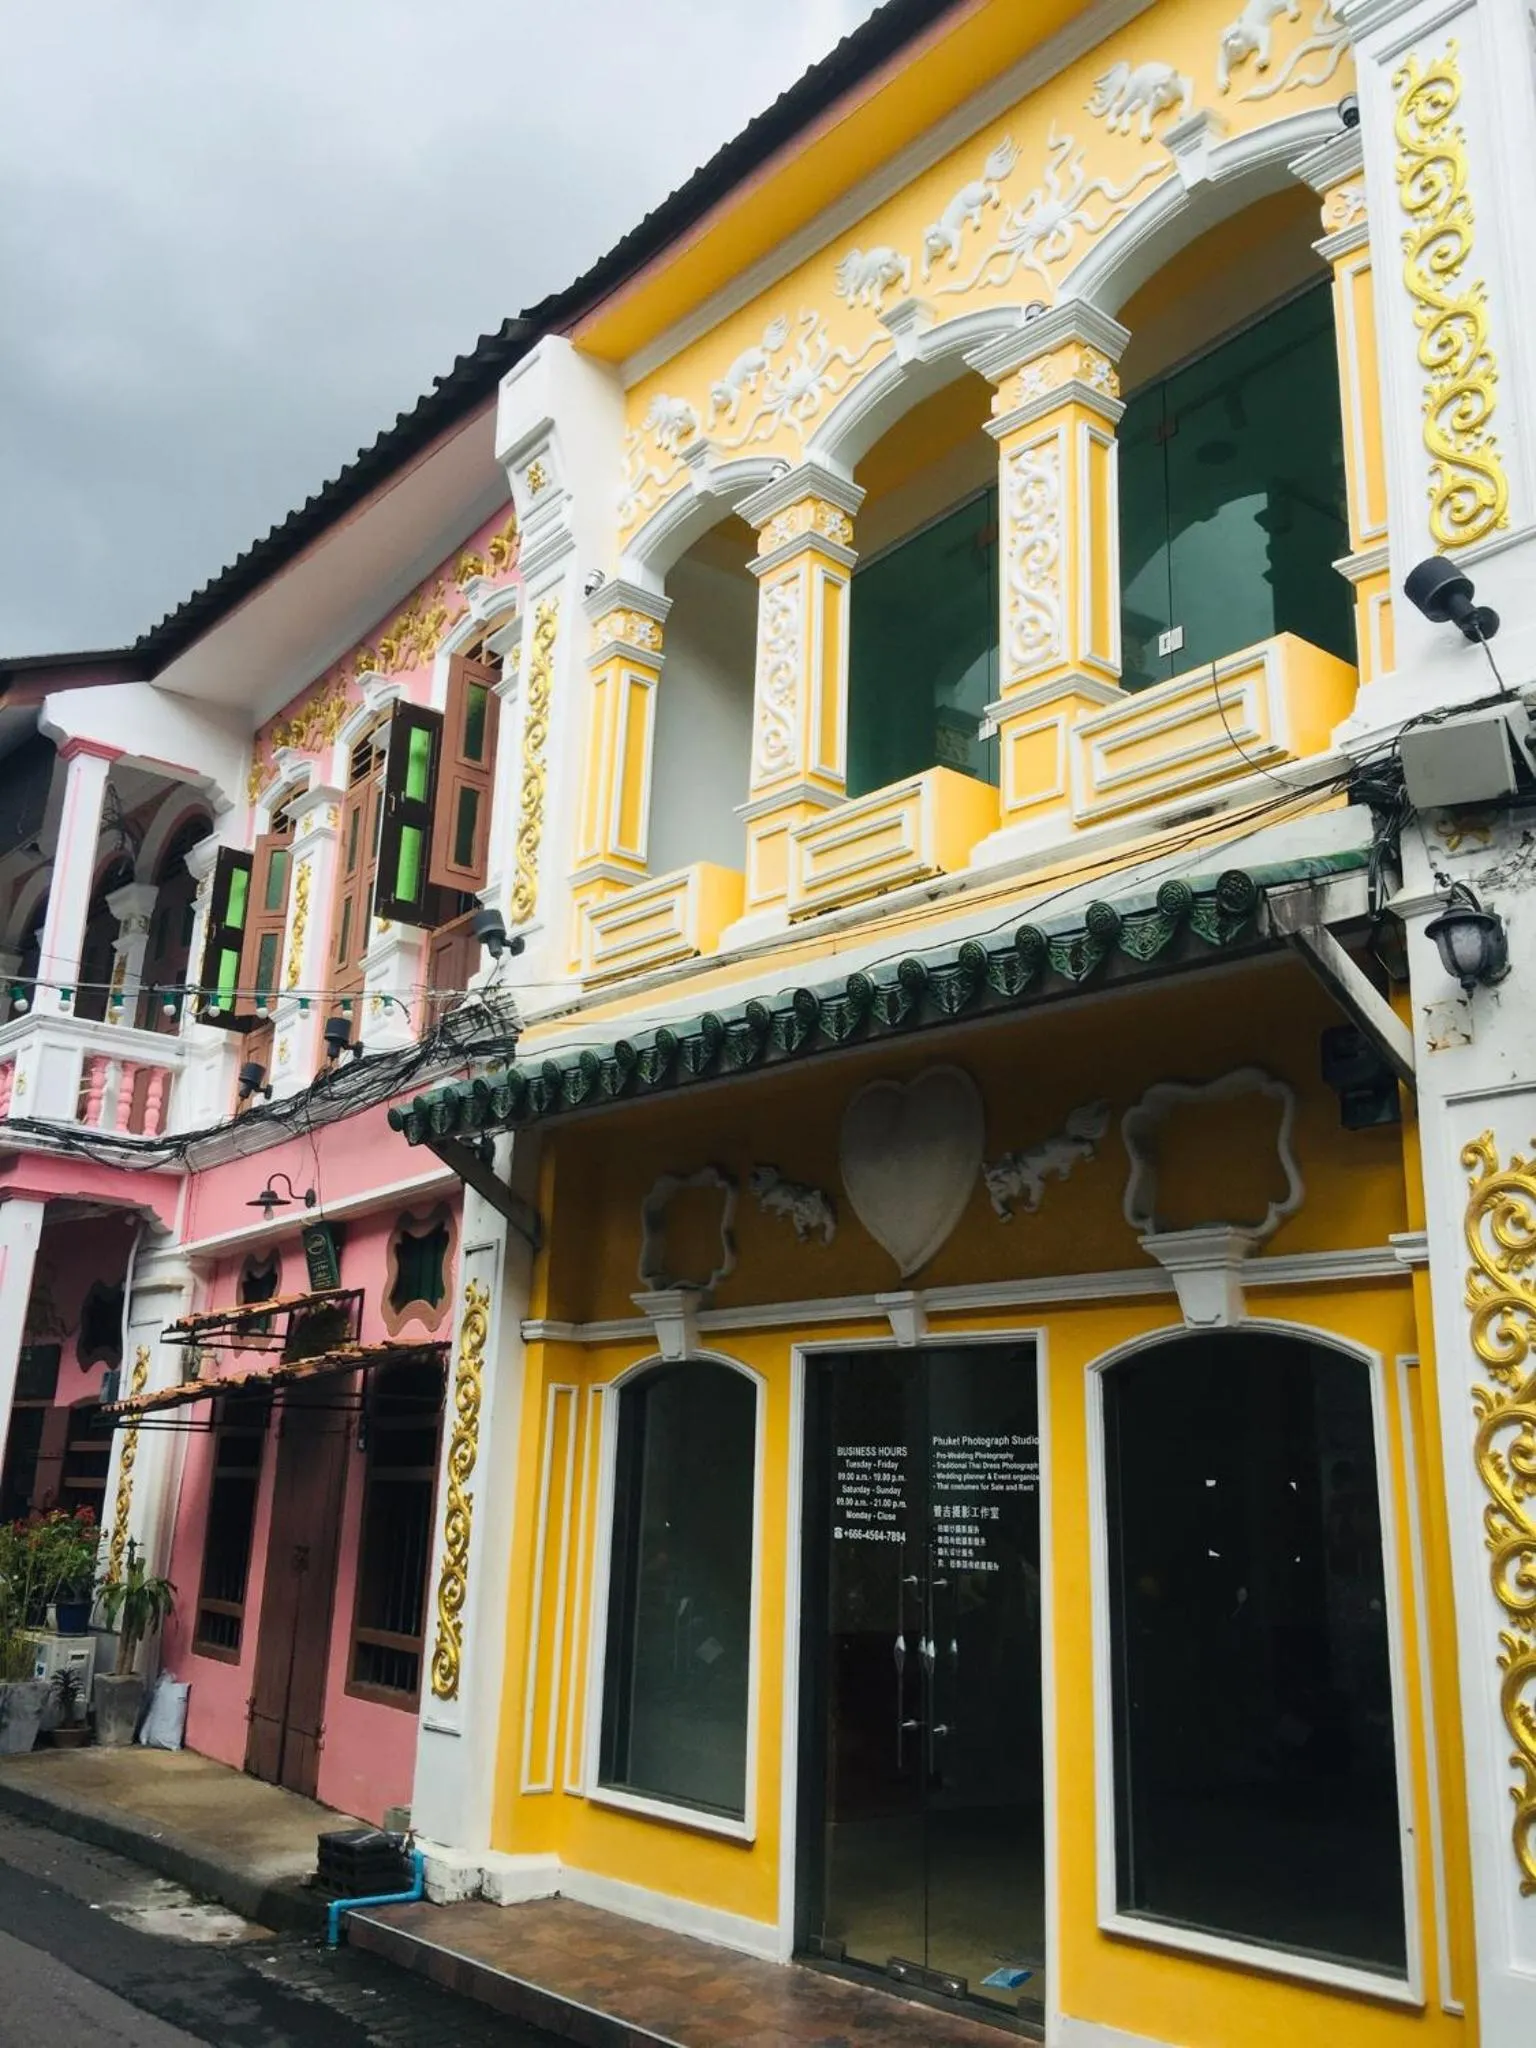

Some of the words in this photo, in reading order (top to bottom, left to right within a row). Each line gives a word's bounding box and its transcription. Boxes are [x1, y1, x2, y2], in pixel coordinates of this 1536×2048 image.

[933, 1436, 960, 1446] Phuket
[962, 1435, 1010, 1448] Photograph
[1011, 1434, 1039, 1446] Studio
[837, 1446, 877, 1457] BUSINESS
[878, 1446, 908, 1457] HOURS
[974, 1451, 1015, 1461] Photography
[846, 1459, 872, 1472] Tuesday
[877, 1459, 899, 1472] Friday
[937, 1462, 967, 1470] Traditional
[936, 1472, 962, 1482] Wedding
[963, 1473, 986, 1482] planner
[987, 1472, 993, 1480] &
[842, 1485, 870, 1496] Saturday
[876, 1485, 901, 1497] Sunday
[937, 1482, 950, 1490] Thai
[950, 1483, 980, 1491] costumes
[980, 1483, 990, 1491] for
[990, 1483, 1004, 1491] Sale
[1018, 1484, 1034, 1492] Rent
[846, 1510, 872, 1522] Monday
[877, 1511, 896, 1521] Close
